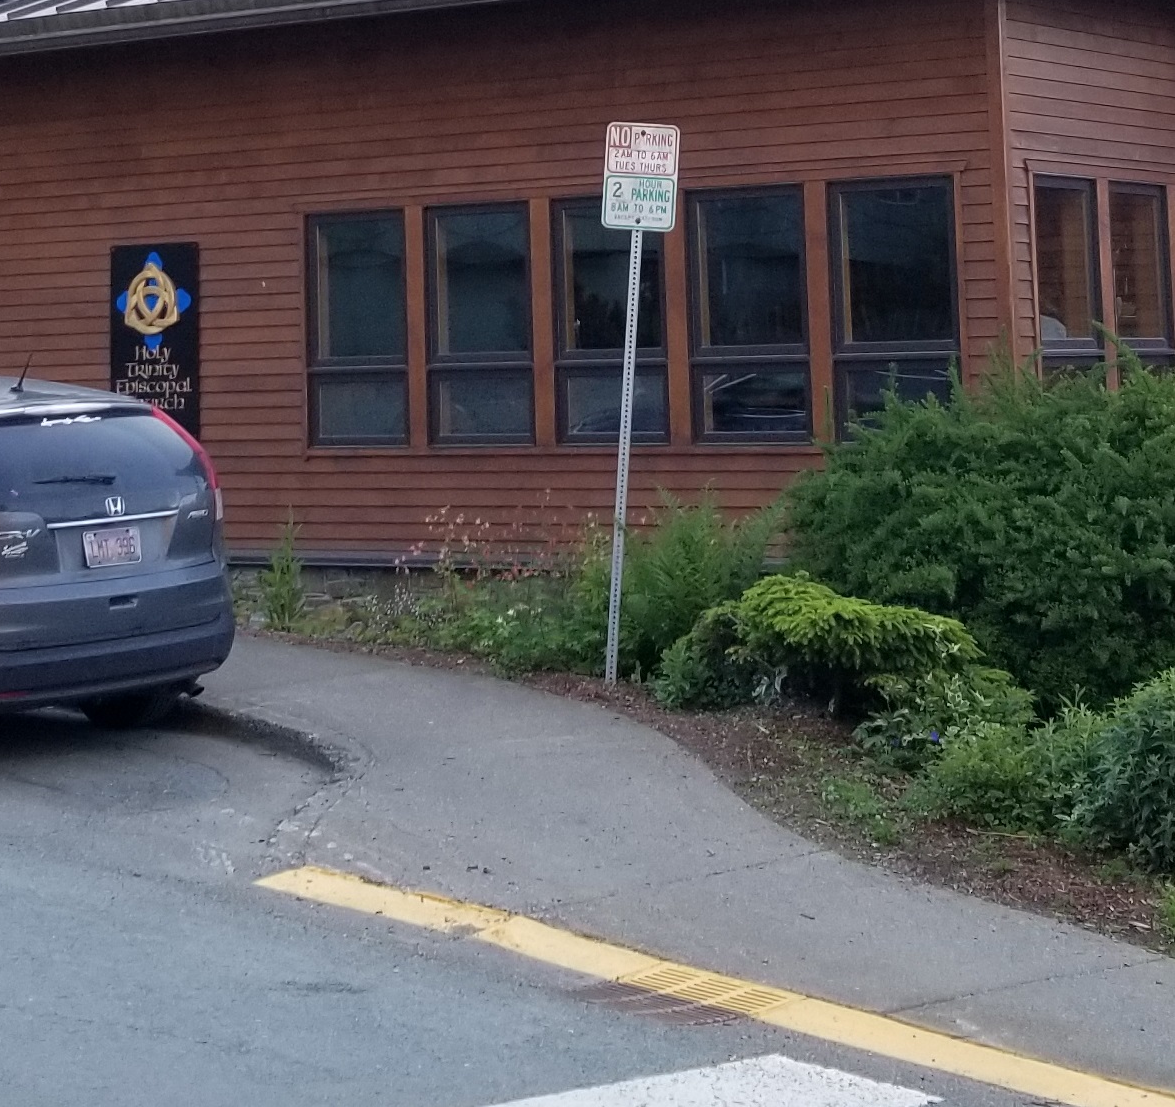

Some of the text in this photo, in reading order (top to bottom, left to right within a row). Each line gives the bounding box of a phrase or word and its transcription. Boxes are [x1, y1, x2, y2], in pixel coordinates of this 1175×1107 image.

[610, 126, 630, 146] NO
[614, 149, 669, 161] 2AM TO 6AM
[615, 161, 667, 172] TUES THURS
[612, 179, 663, 198] 2 HOUR
[631, 188, 671, 203] PARKING
[611, 203, 629, 212] 8AM
[634, 204, 644, 213] TO
[135, 345, 172, 362] Holy
[116, 377, 193, 398] Episcopal
[139, 393, 185, 410] urch
[90, 539, 110, 558] LMT
